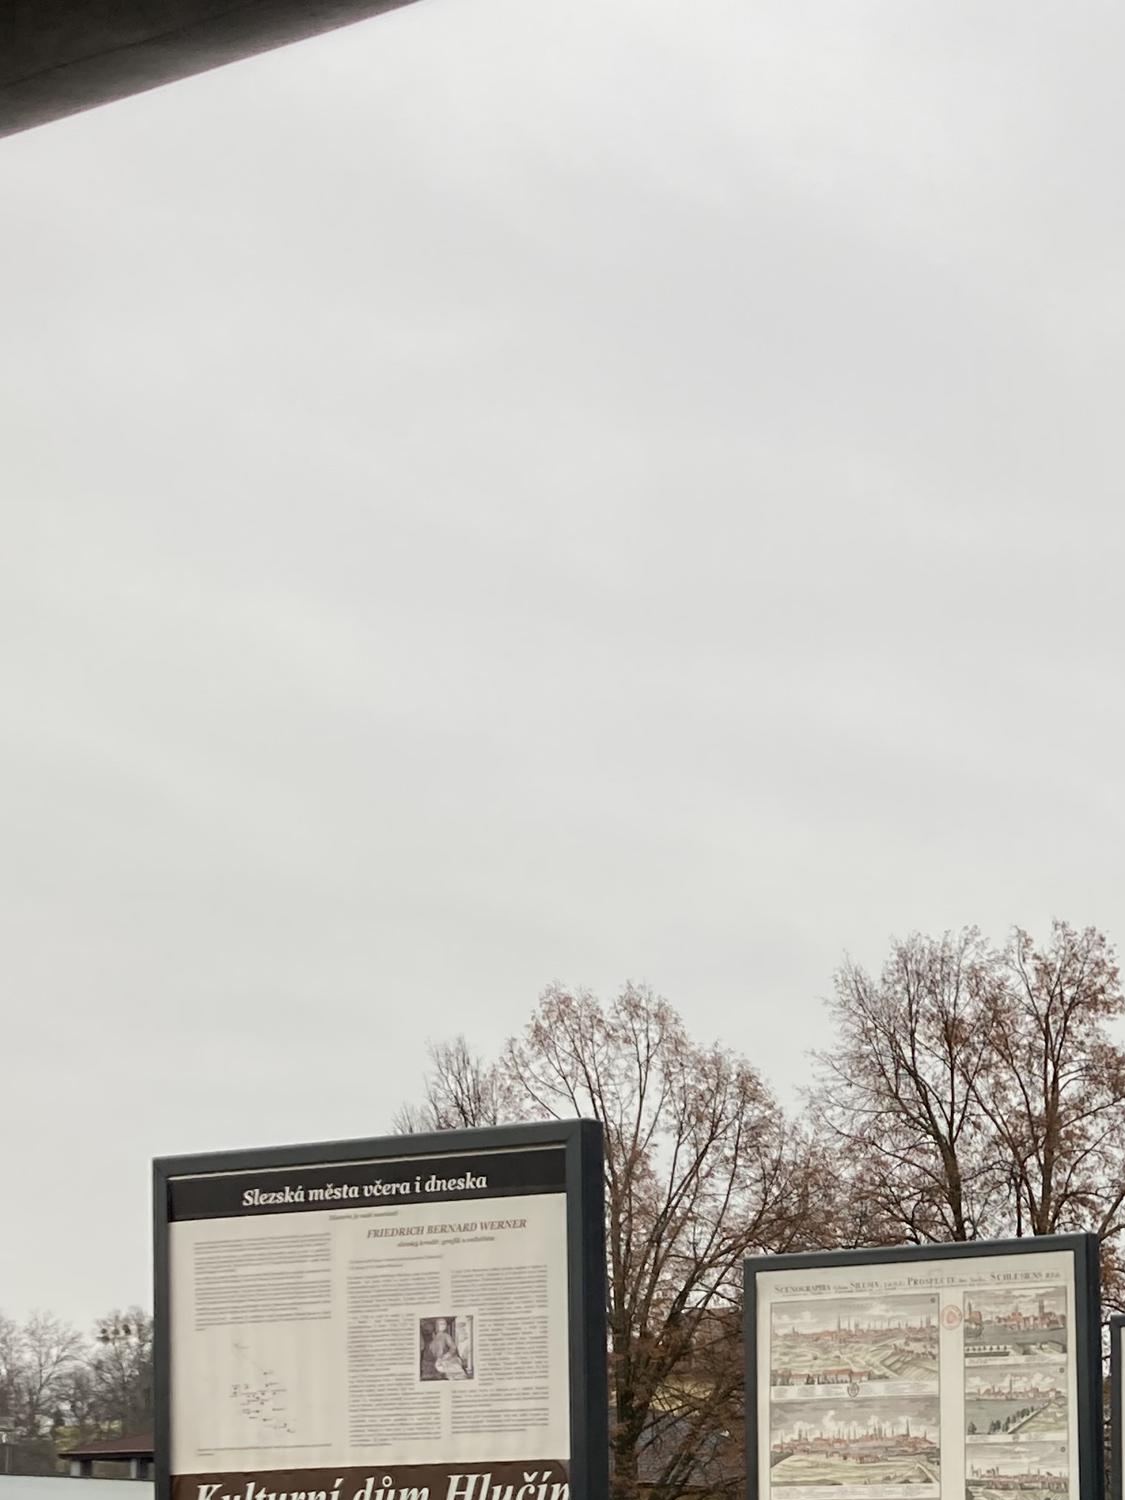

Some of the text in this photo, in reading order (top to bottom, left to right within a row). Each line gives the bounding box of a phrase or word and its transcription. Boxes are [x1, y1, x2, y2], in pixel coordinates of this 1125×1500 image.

[242, 1172, 488, 1206] Slezská města včera i dneska
[366, 1218, 528, 1239] FRIEDRICH BERNARD WERNER
